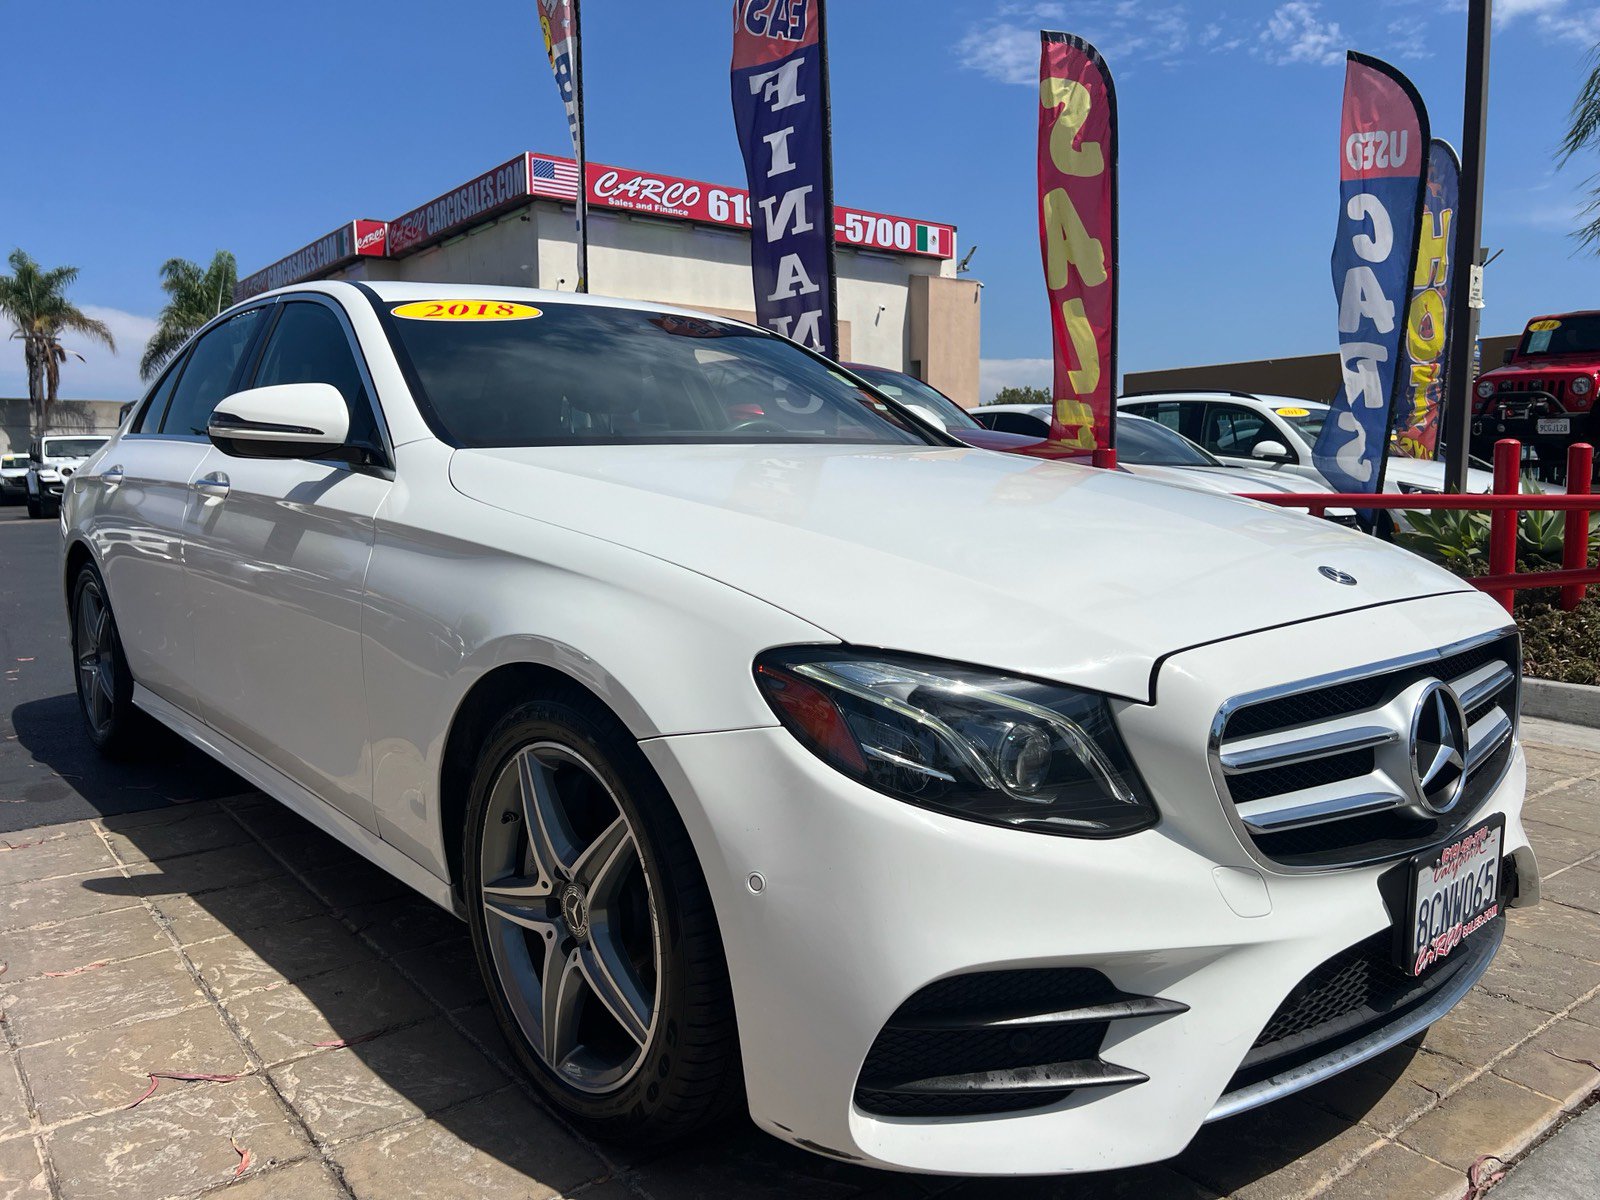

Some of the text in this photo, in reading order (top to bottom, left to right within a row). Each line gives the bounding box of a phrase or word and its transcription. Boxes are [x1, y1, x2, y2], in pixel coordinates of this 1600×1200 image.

[426, 159, 525, 236] CARCOSALES.COM
[593, 171, 701, 208] CARCO
[608, 197, 689, 217] Sales and Finance
[357, 228, 385, 248] CARCO
[267, 234, 338, 290] CARCOSALES.COM
[424, 304, 515, 317] 2018
[1416, 857, 1495, 948] 8CNW065
